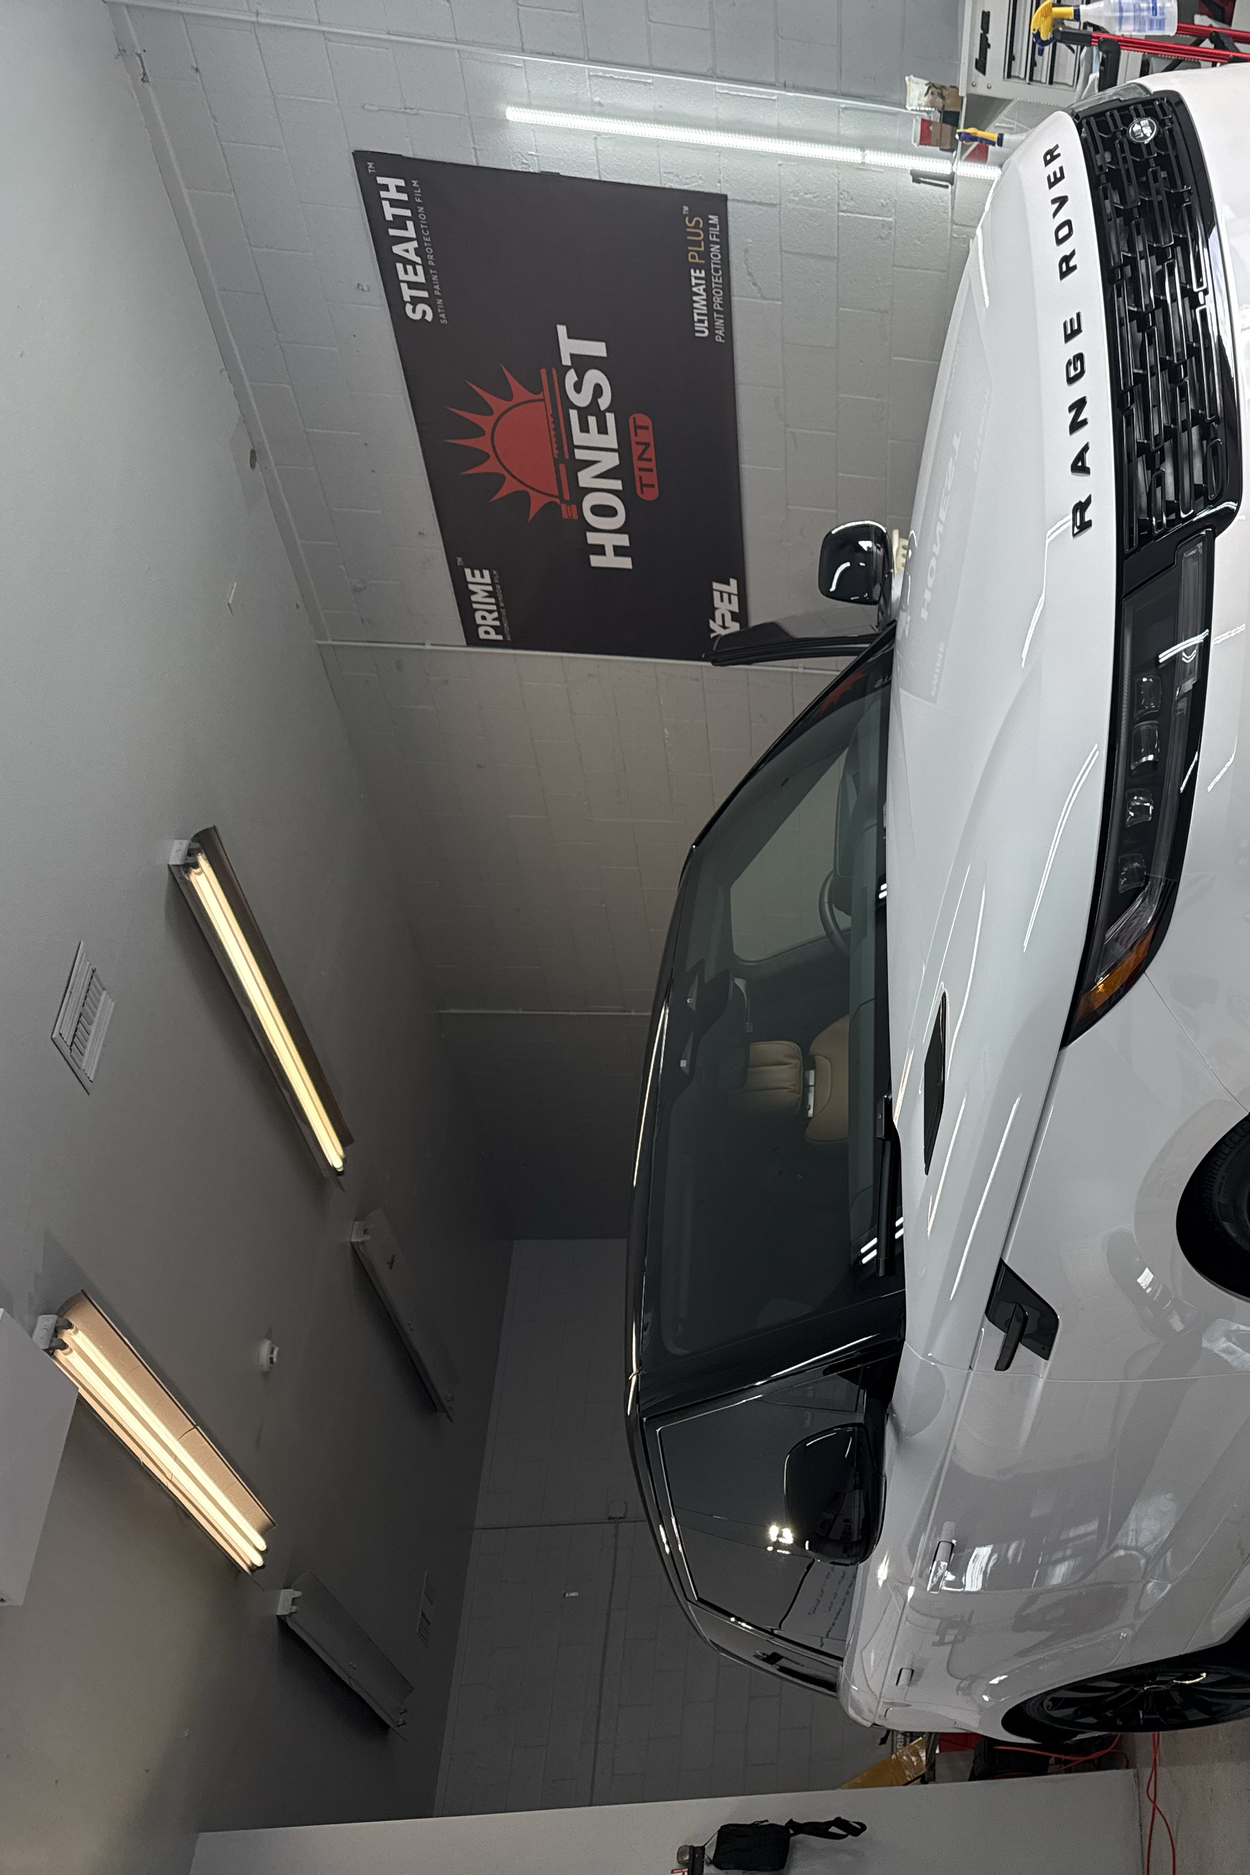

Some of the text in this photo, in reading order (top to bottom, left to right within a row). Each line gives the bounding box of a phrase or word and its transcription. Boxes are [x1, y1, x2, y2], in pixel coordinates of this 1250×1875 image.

[376, 177, 433, 322] STEALTH
[412, 180, 447, 324] SATIN PAINT PROTECTION FILM
[686, 217, 705, 264] PLUS
[691, 269, 709, 337] ULTIMATE
[709, 215, 725, 343] PAINT PROTECTION FILM
[1042, 143, 1092, 539] RANGE ROVER
[557, 324, 634, 570] HONEST
[632, 417, 655, 495] TINT
[464, 568, 503, 640] PRIME
